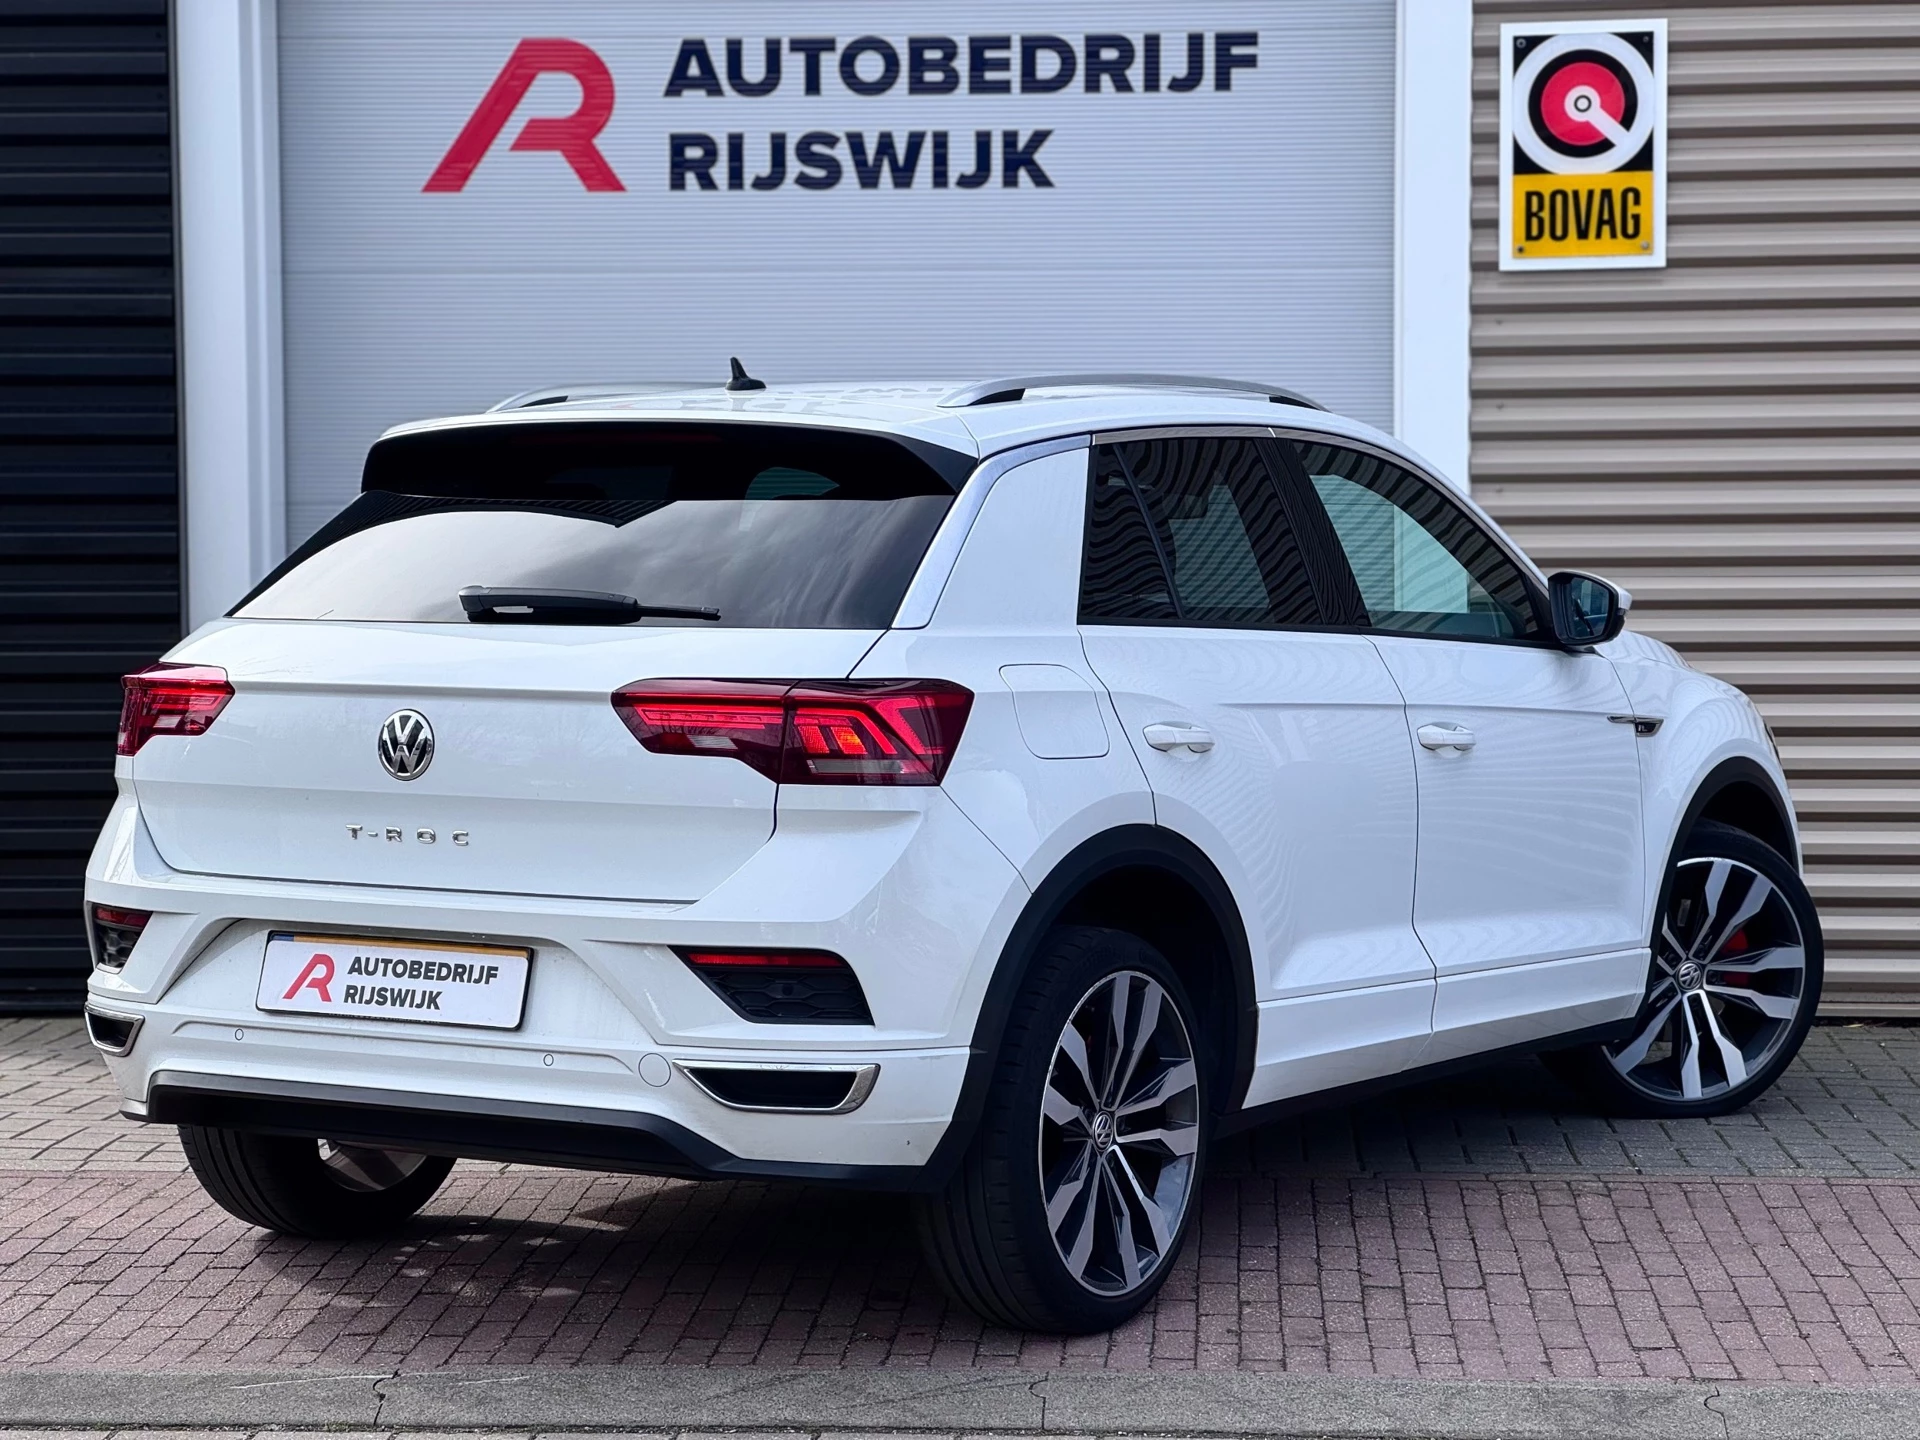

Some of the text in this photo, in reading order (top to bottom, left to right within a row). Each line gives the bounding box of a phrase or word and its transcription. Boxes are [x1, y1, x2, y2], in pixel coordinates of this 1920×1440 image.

[664, 32, 1258, 97] AUTOBEDRIJF
[669, 130, 1054, 190] RIJSWIJK
[1524, 187, 1641, 242] BOVAG
[345, 824, 469, 847] T-ROC
[347, 956, 499, 985] AUTOBEDRIJF
[343, 984, 443, 1010] RIJSWIJK
